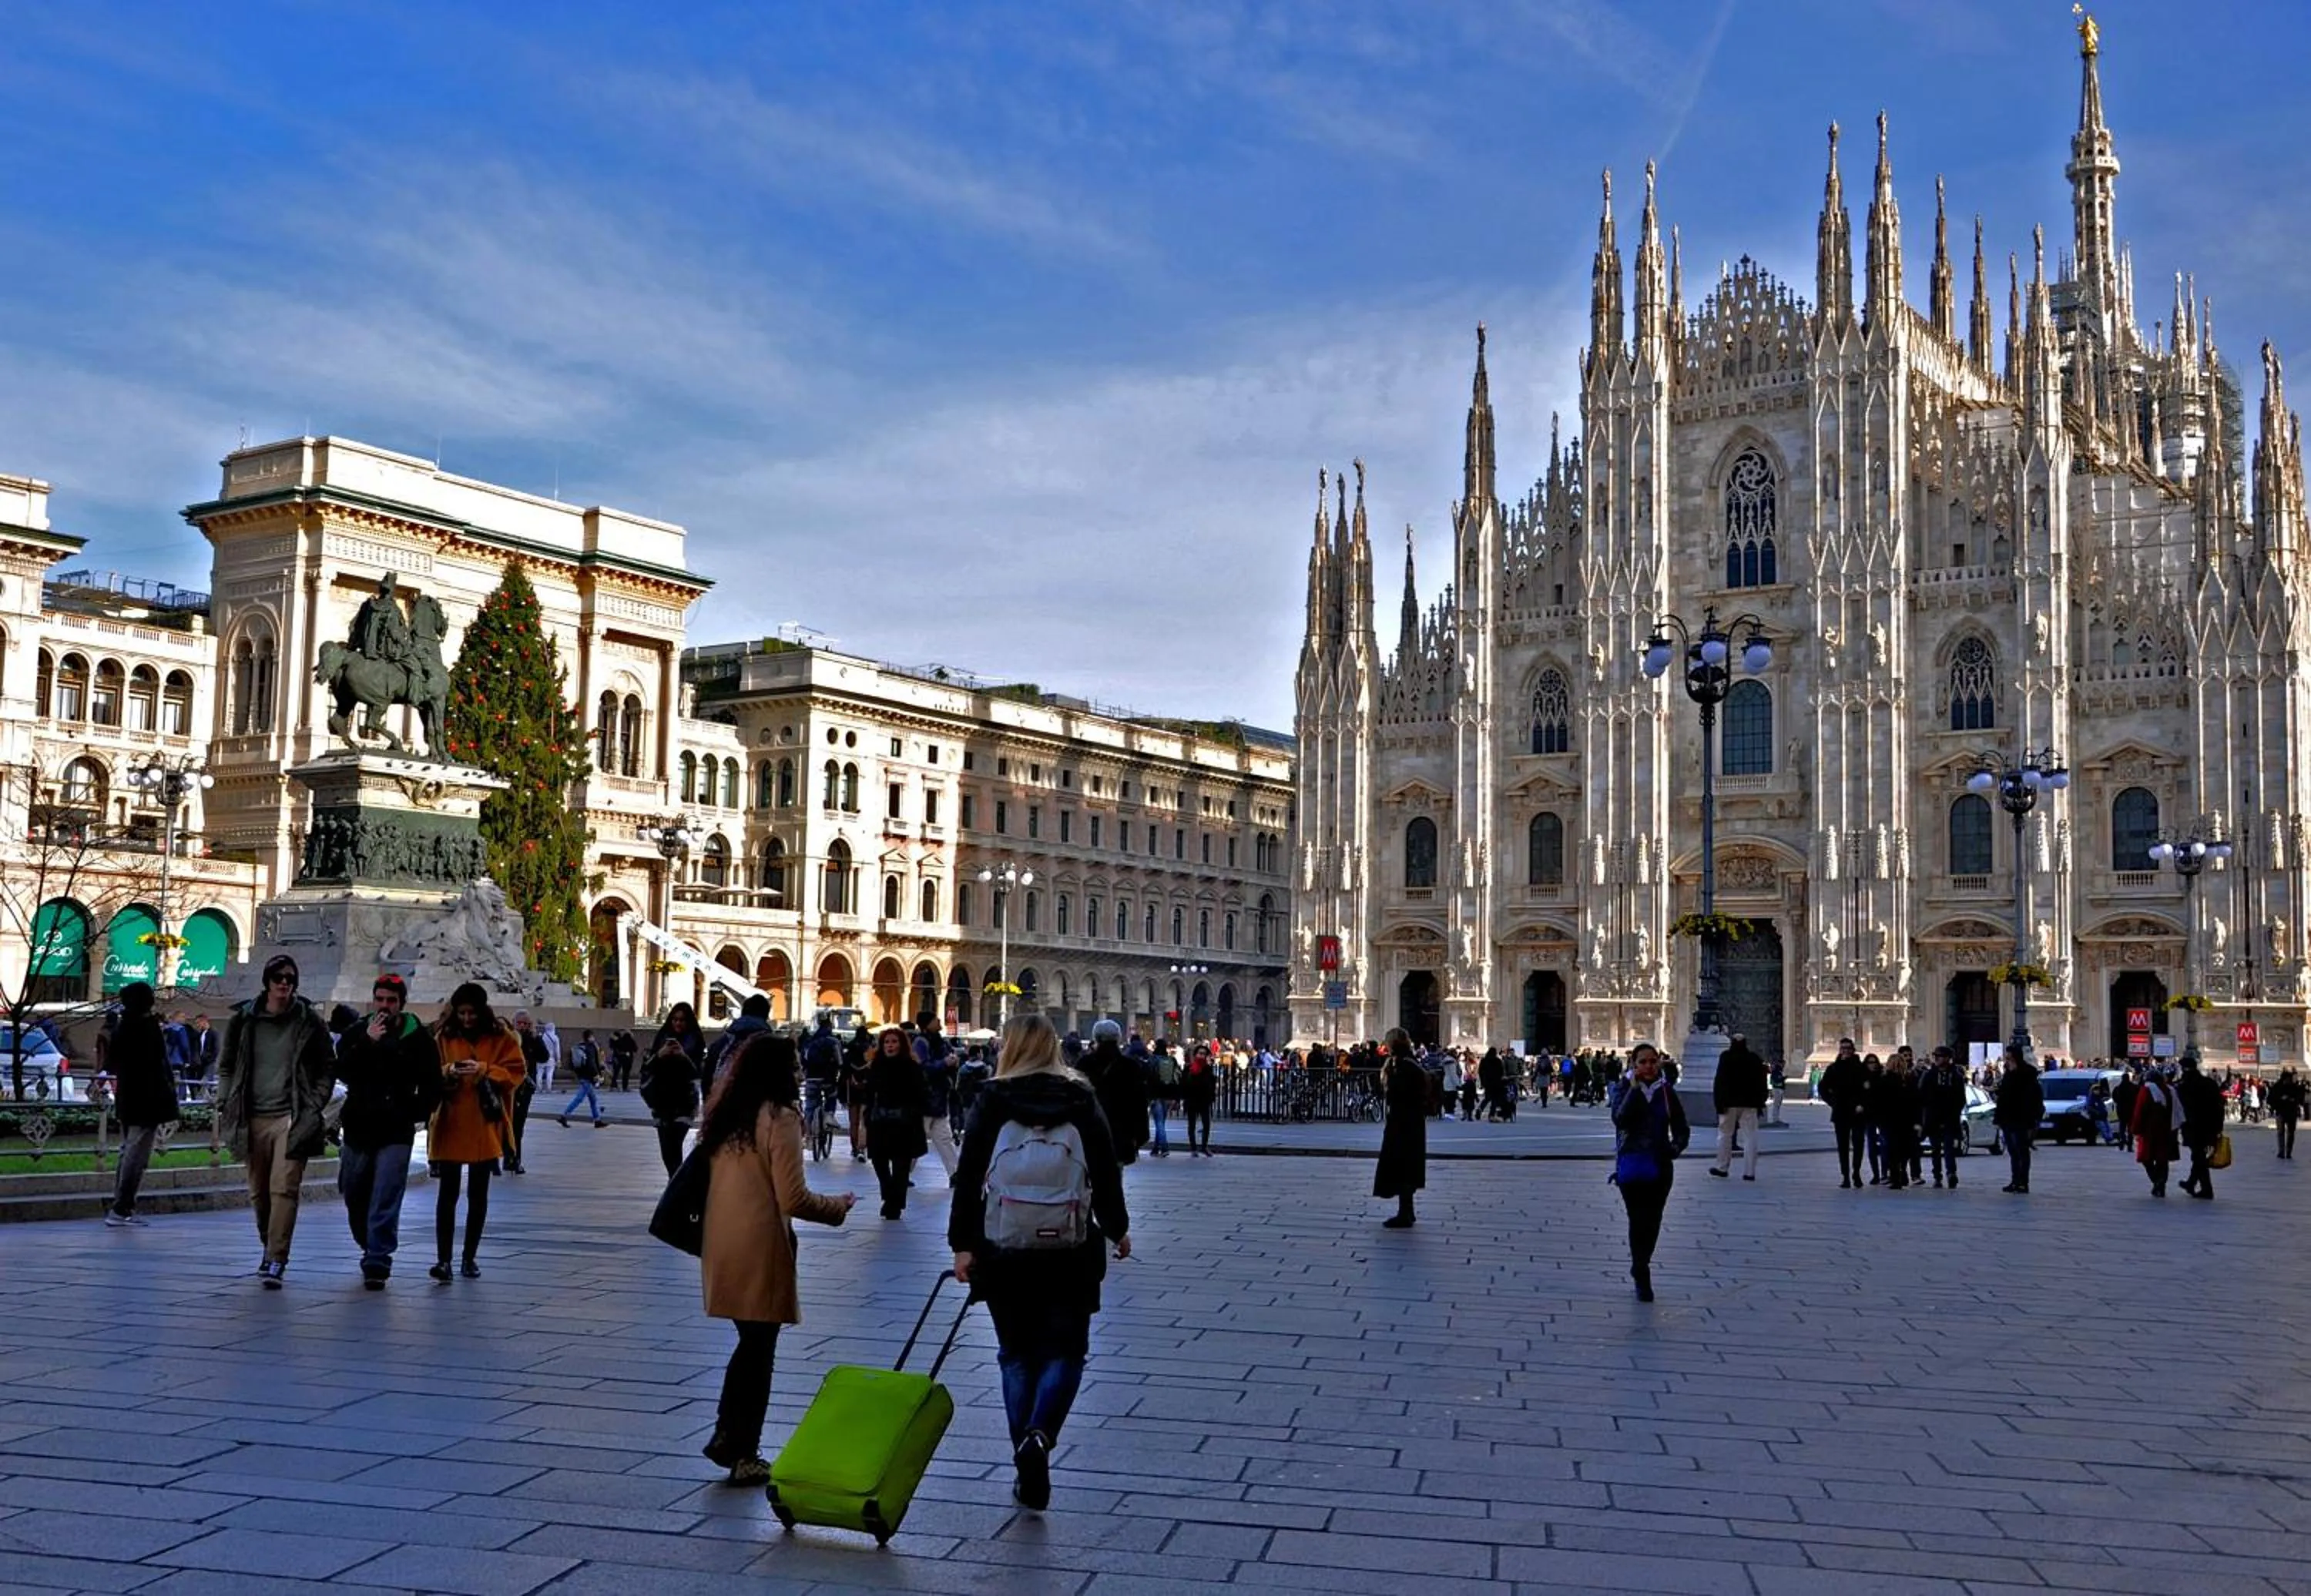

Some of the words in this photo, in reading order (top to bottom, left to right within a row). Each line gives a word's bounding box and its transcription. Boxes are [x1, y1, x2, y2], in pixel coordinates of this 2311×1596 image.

[1323, 944, 1337, 964] M
[947, 1010, 956, 1021] M
[2129, 1013, 2147, 1026] M
[2239, 1026, 2254, 1038] M
